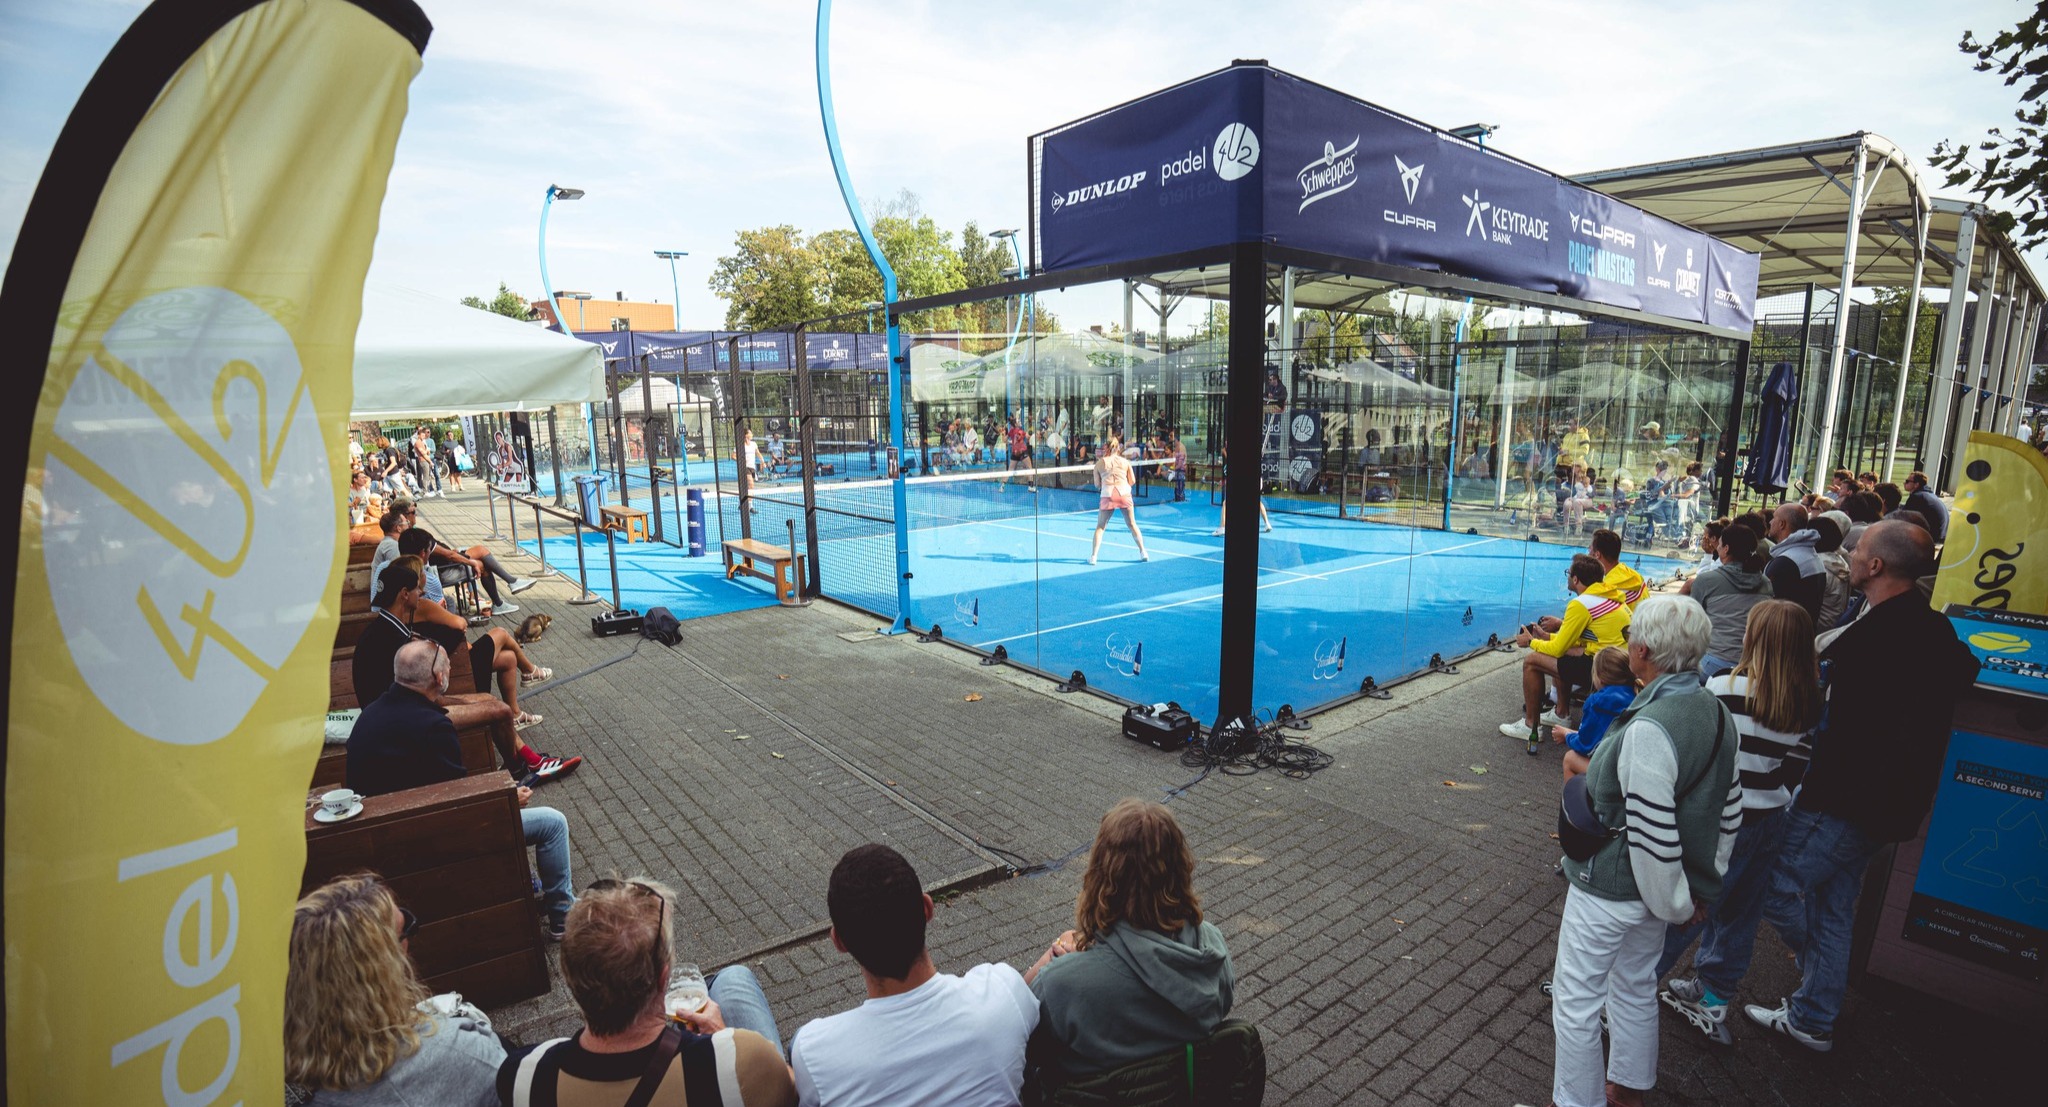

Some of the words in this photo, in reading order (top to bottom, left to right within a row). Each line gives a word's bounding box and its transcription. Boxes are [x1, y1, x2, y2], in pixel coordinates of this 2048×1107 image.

[1161, 146, 1206, 186] padel
[1216, 122, 1255, 176] 4U2
[1300, 153, 1356, 199] Schweppes
[1065, 171, 1147, 206] DUNLOP
[1383, 209, 1437, 232] CUPRA
[1491, 206, 1549, 242] KEYTRADE
[1492, 232, 1512, 245] BANK
[1581, 218, 1636, 249] CUPRA
[1568, 240, 1596, 278] PADEL
[1597, 248, 1636, 287] MASTERS
[1647, 276, 1671, 290] CUPRA
[660, 346, 703, 355] KEYTADE
[718, 350, 743, 362] PAL
[744, 350, 779, 362] MASTERS
[1262, 421, 1280, 434] pad
[1261, 461, 1280, 474] pad
[1988, 657, 2034, 668] GOT
[1965, 775, 2008, 791] SECOND
[2009, 785, 2043, 799] SERVE
[1928, 922, 1961, 937] KEYTRADE
[1941, 909, 1977, 925] CIRCULAR
[1978, 920, 2014, 936] INITIATIVE
[2015, 932, 2025, 940] BY
[110, 827, 242, 1107] del
